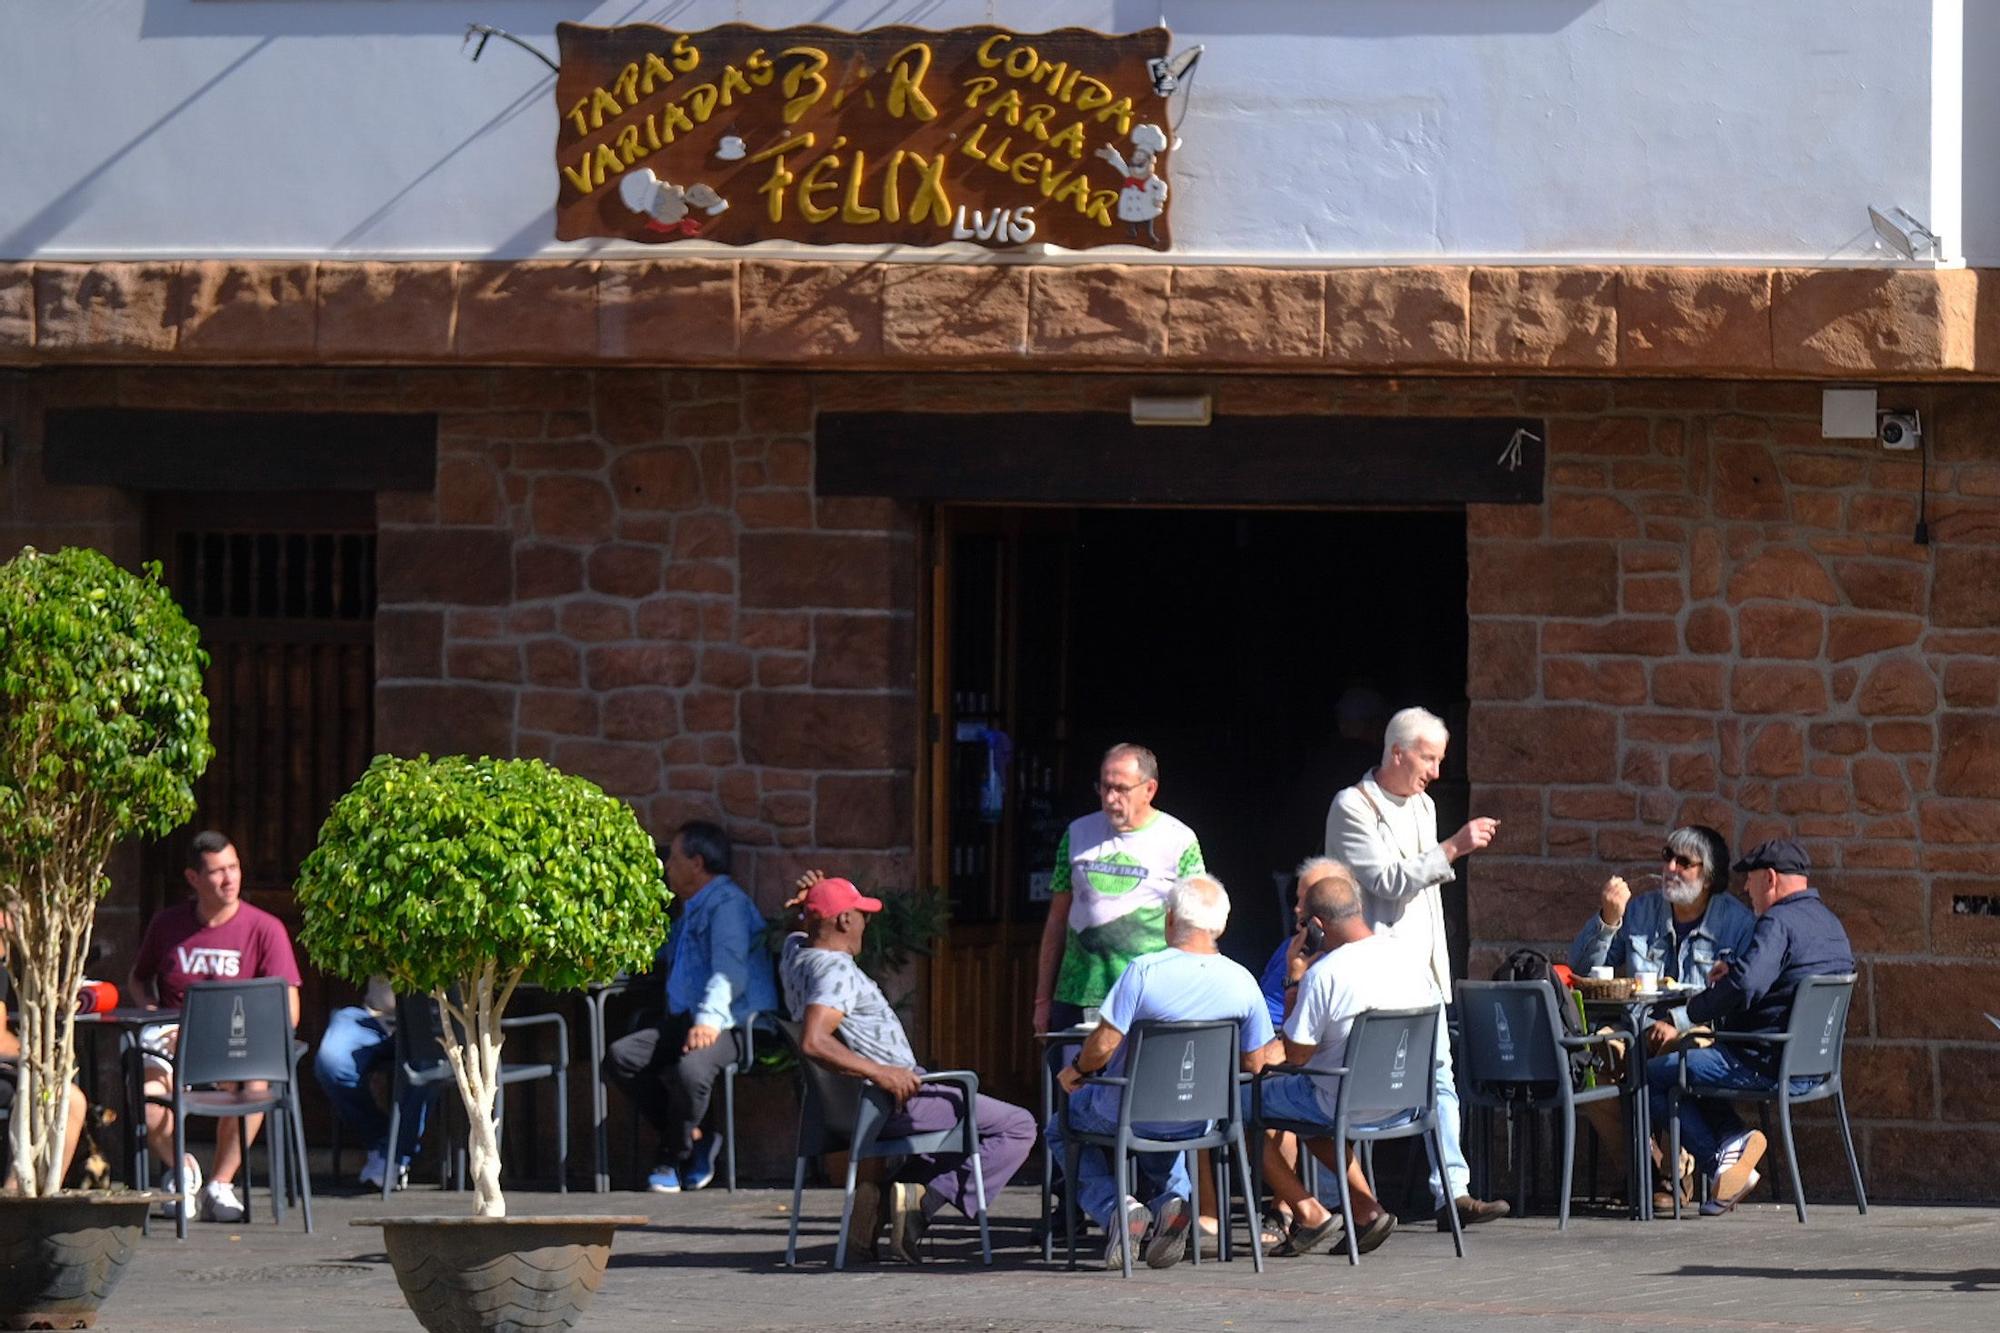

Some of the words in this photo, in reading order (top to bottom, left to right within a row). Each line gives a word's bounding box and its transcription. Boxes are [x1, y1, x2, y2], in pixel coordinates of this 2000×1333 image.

[563, 48, 776, 194] VARIADAS
[566, 35, 700, 137] TAPAS
[962, 76, 1086, 159] PARA
[977, 34, 1134, 135] COMIDA
[953, 204, 1036, 243] LUIS
[962, 123, 1119, 226] LLEVAR
[177, 946, 241, 977] VANS
